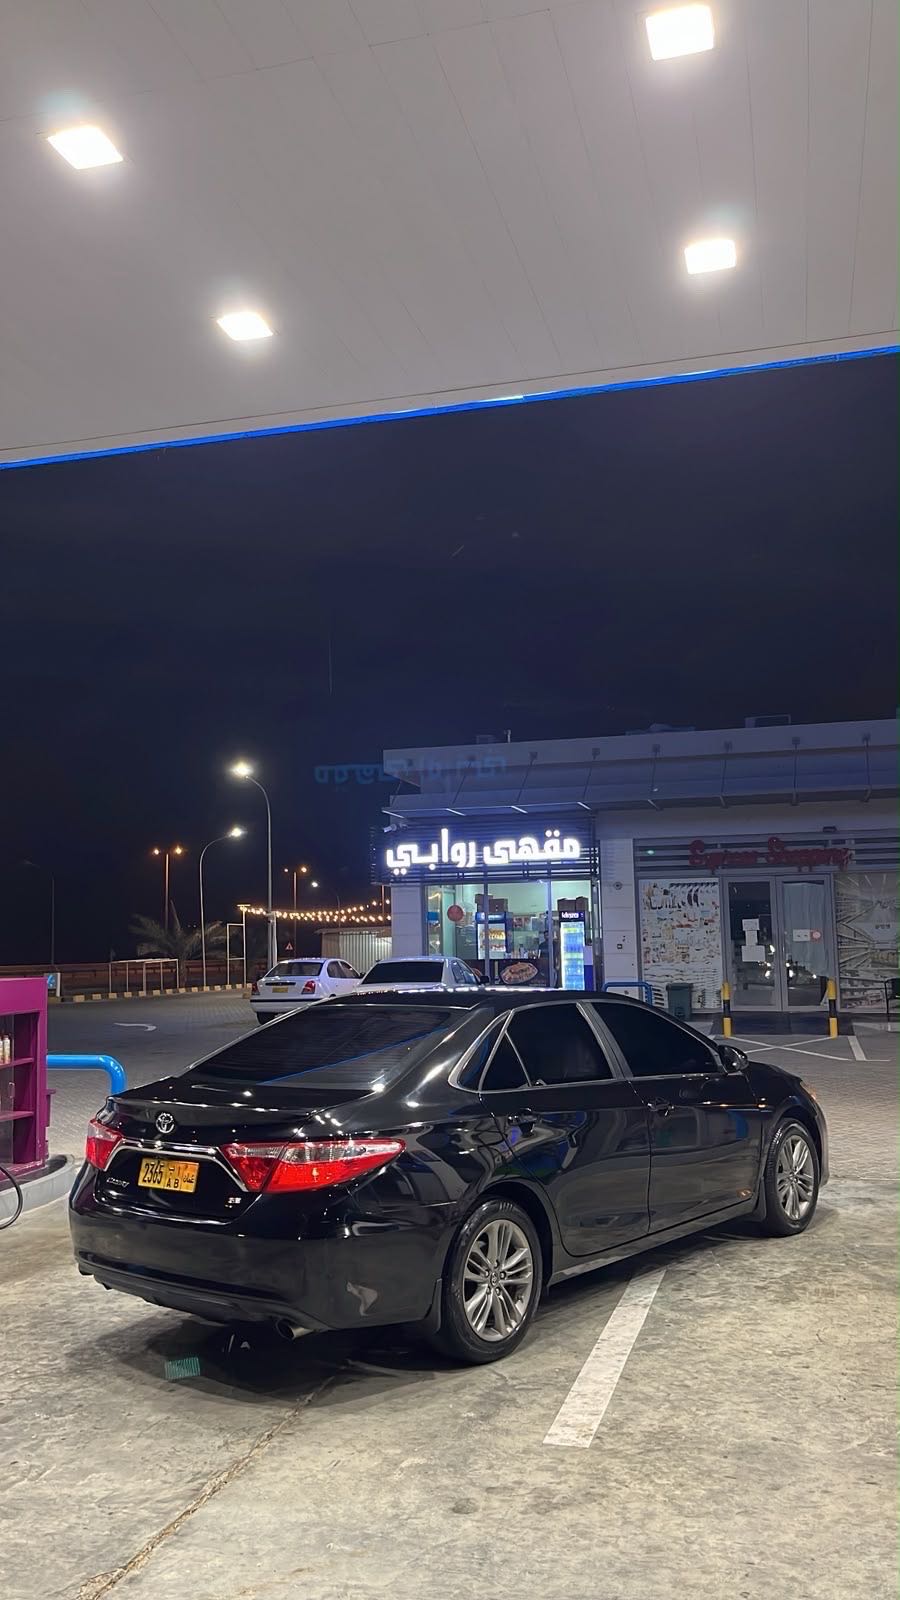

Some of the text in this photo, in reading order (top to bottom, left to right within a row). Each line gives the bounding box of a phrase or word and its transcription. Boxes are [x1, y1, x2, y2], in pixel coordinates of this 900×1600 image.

[386, 828, 581, 876] مقهى روابي
[142, 1160, 165, 1184] 2365
